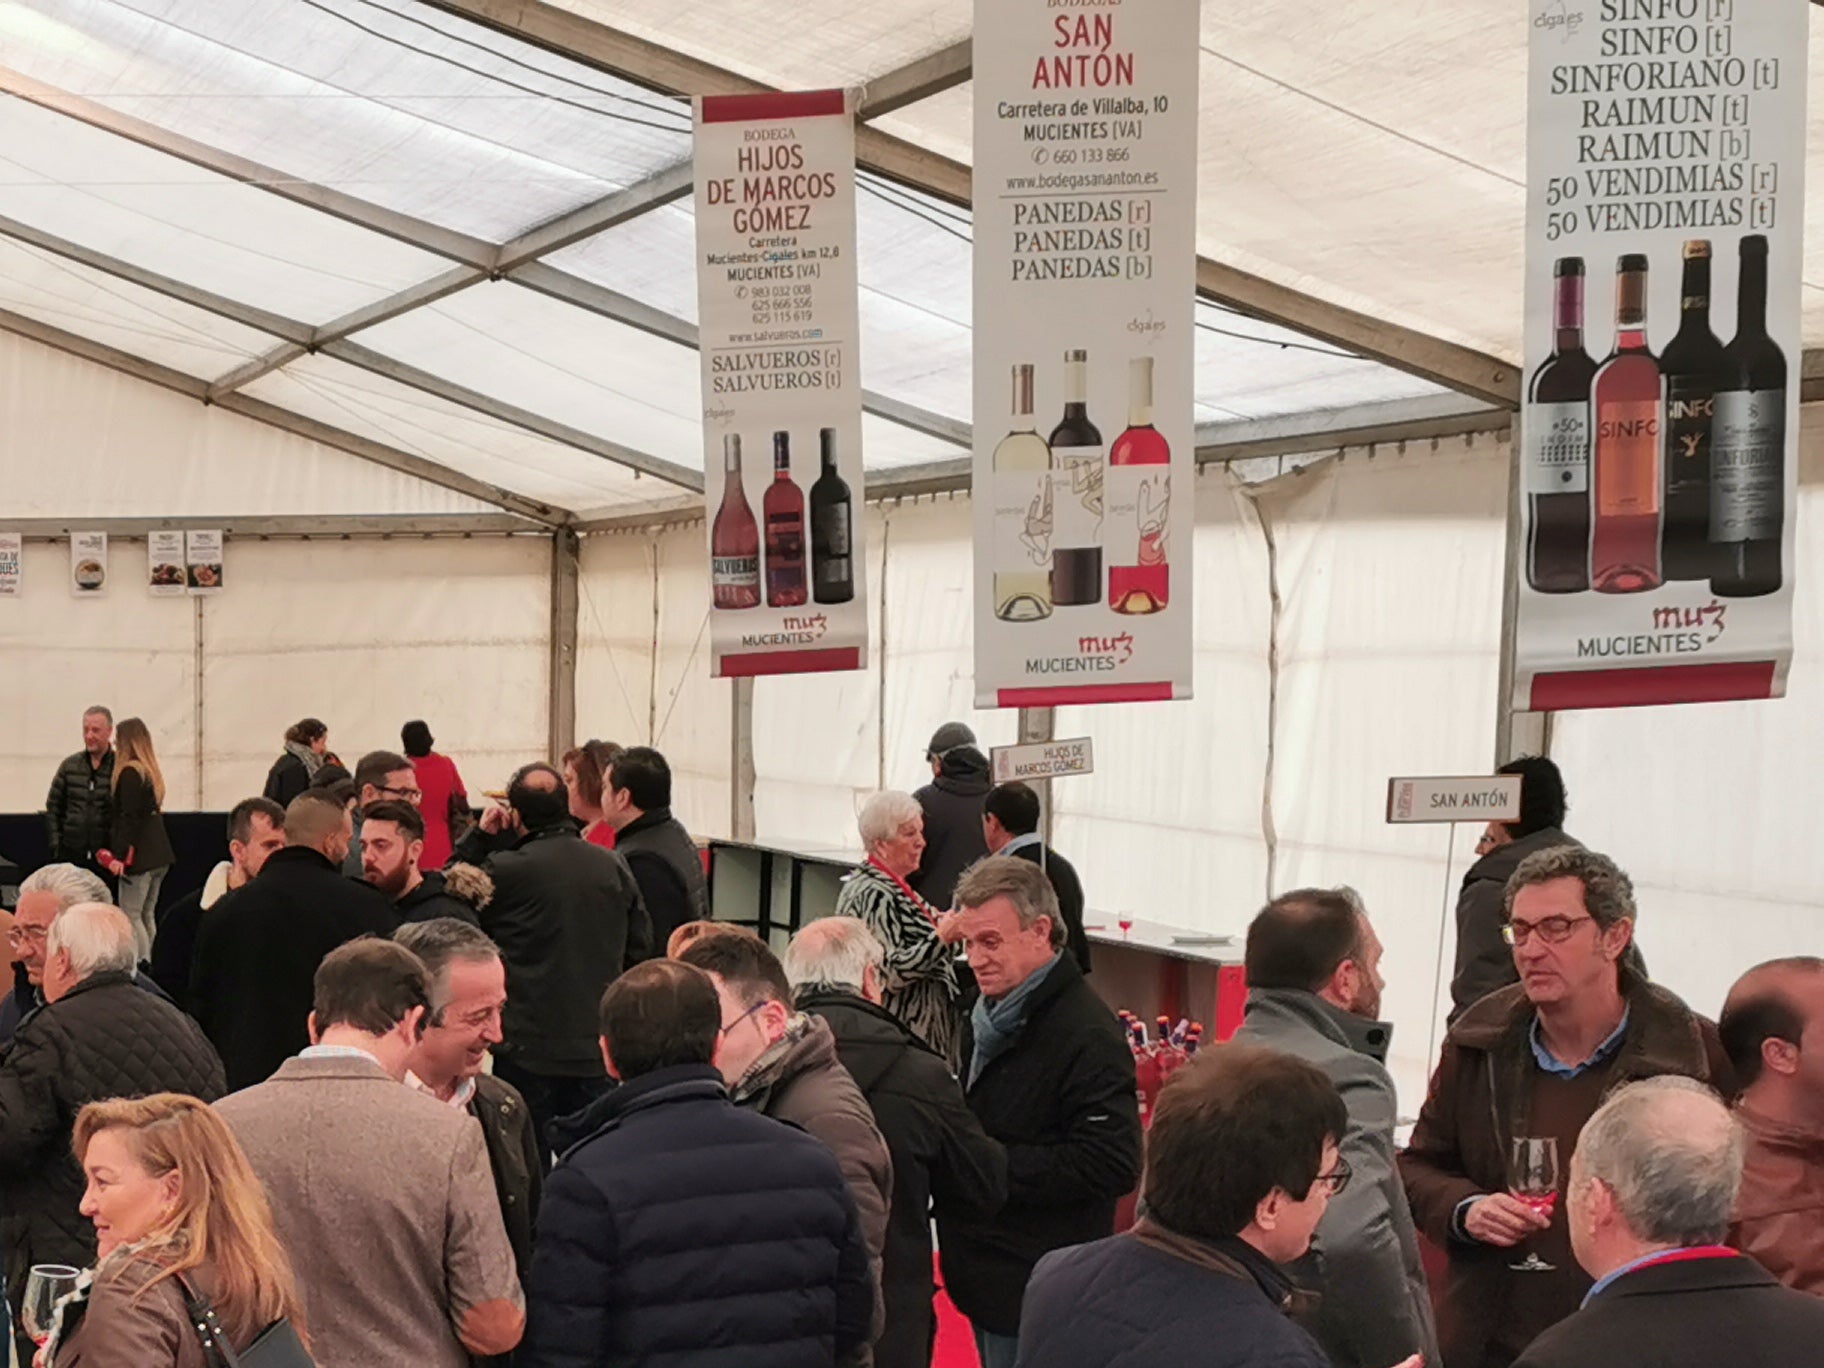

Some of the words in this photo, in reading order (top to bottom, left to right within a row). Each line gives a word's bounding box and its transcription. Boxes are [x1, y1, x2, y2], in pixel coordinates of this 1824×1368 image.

[1600, 0, 1698, 23] SINFO
[1053, 13, 1113, 48] SAN
[1600, 25, 1698, 58] SINFO
[1705, 25, 1731, 58] [t]
[1032, 45, 1134, 90] ANTÓN
[1550, 58, 1745, 95] SINFORIANO
[1753, 58, 1779, 91] [t]
[997, 100, 1067, 119] Carretera
[1070, 99, 1089, 116] de
[1092, 97, 1149, 116] Villalba,
[1153, 95, 1168, 114] 10
[1581, 94, 1717, 129] RAIMUN
[1722, 94, 1749, 127] [t]
[743, 127, 796, 142] BODEGA
[1024, 121, 1108, 142] MUCIENTES
[1112, 119, 1142, 141] [VA]
[738, 143, 804, 172] HIJOS
[1053, 150, 1077, 164] 660
[1081, 149, 1104, 164] 133
[1106, 147, 1130, 162] 866
[1577, 129, 1713, 164] RAIMUN
[1719, 129, 1751, 162] [b]
[707, 178, 736, 205] DE
[743, 172, 836, 204] MARCOS
[1006, 171, 1159, 191] www.bodegasananton.es
[1546, 176, 1578, 207] 50
[1584, 162, 1744, 198] VENDIMIAS
[1750, 162, 1778, 195] [r]
[733, 202, 811, 233] GÓMEZ
[1013, 199, 1123, 226] PANEDAS
[1127, 199, 1152, 225] [r]
[1546, 211, 1578, 242] 50
[1584, 197, 1744, 232] VENDIMIAS
[1749, 197, 1776, 230] [t]
[749, 235, 798, 248] Carretera
[1013, 227, 1123, 253] PANEDAS
[1128, 227, 1151, 252] [t]
[727, 264, 794, 282] MUCIENTES
[797, 262, 821, 279] [VA]
[1011, 255, 1121, 281] PANEDAS
[1125, 254, 1153, 281] [b]
[711, 350, 821, 373] SALVUEROS
[712, 370, 823, 394] SALVUEROS
[741, 631, 815, 648] MUCIENTES
[1576, 632, 1703, 658] MUCIENTES
[1025, 655, 1116, 674] MUCIENTES
[1430, 792, 1458, 809] SAN
[1461, 787, 1509, 808] ANTÓN
